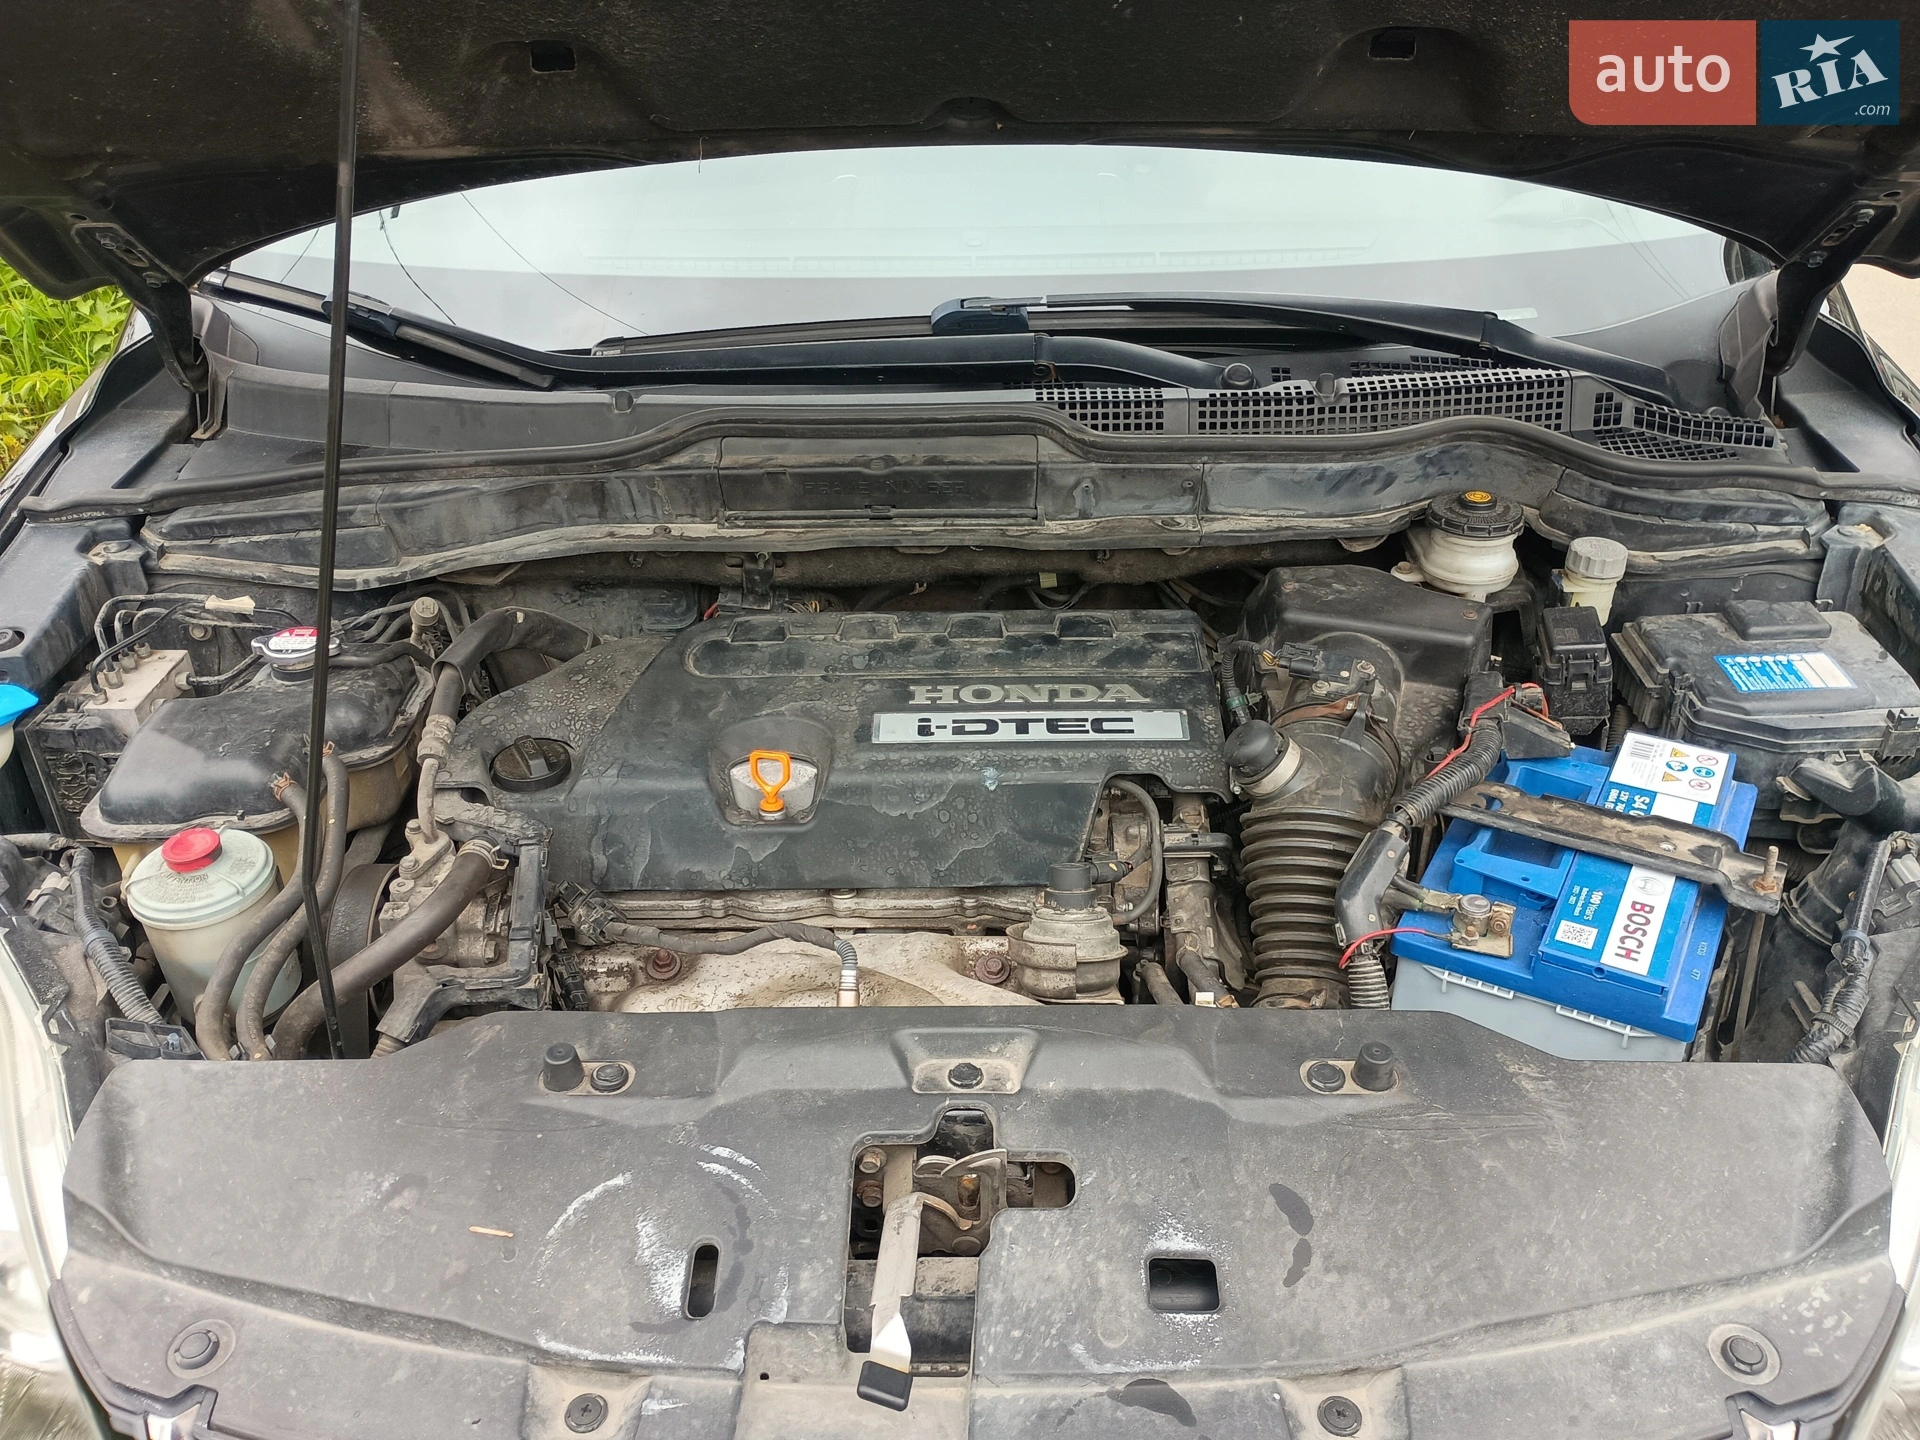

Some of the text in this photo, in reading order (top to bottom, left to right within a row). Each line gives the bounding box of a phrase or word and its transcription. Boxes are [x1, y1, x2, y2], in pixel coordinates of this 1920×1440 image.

[908, 683, 1150, 705] HONDA
[917, 717, 1135, 737] i-DTEC
[1631, 794, 1650, 810] S4
[1583, 890, 1604, 921] 100 Years
[1614, 900, 1655, 962] BOSCH
